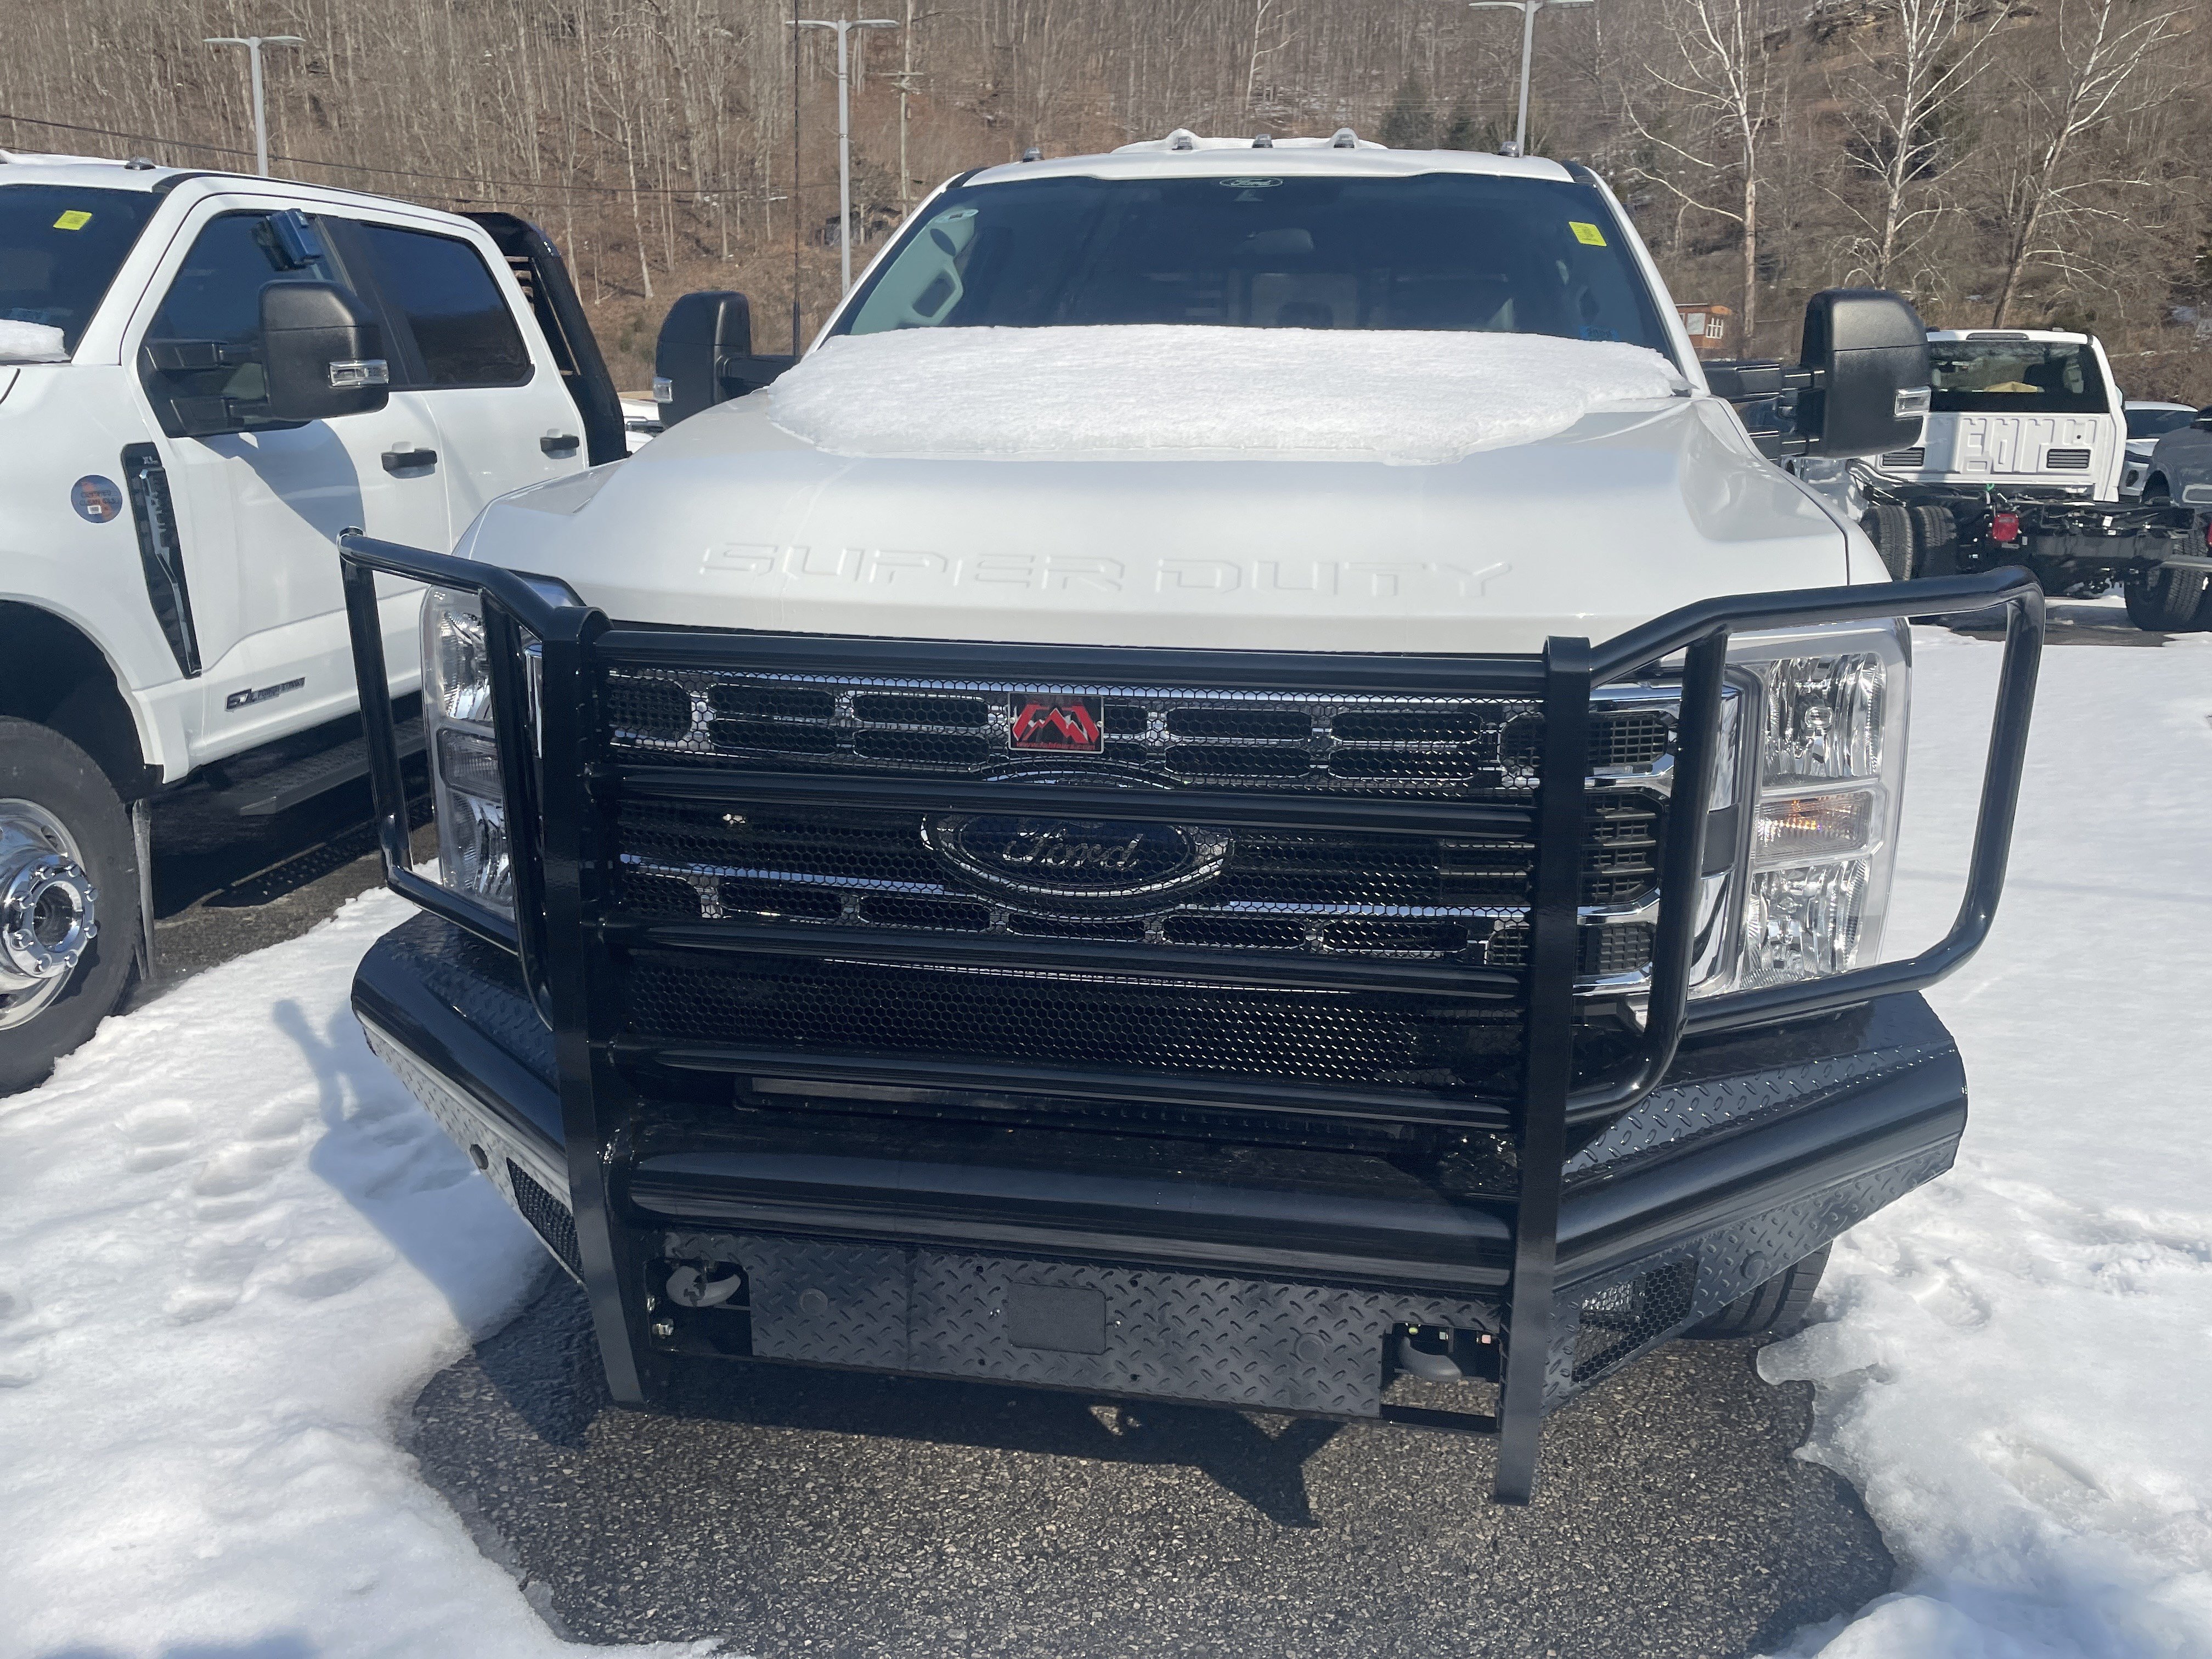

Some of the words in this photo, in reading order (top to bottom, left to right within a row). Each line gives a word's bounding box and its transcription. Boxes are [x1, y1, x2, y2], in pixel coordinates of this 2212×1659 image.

[699, 541, 1126, 592] SUPER
[1153, 557, 1514, 597] DUTY
[1002, 819, 1143, 869] Ford
